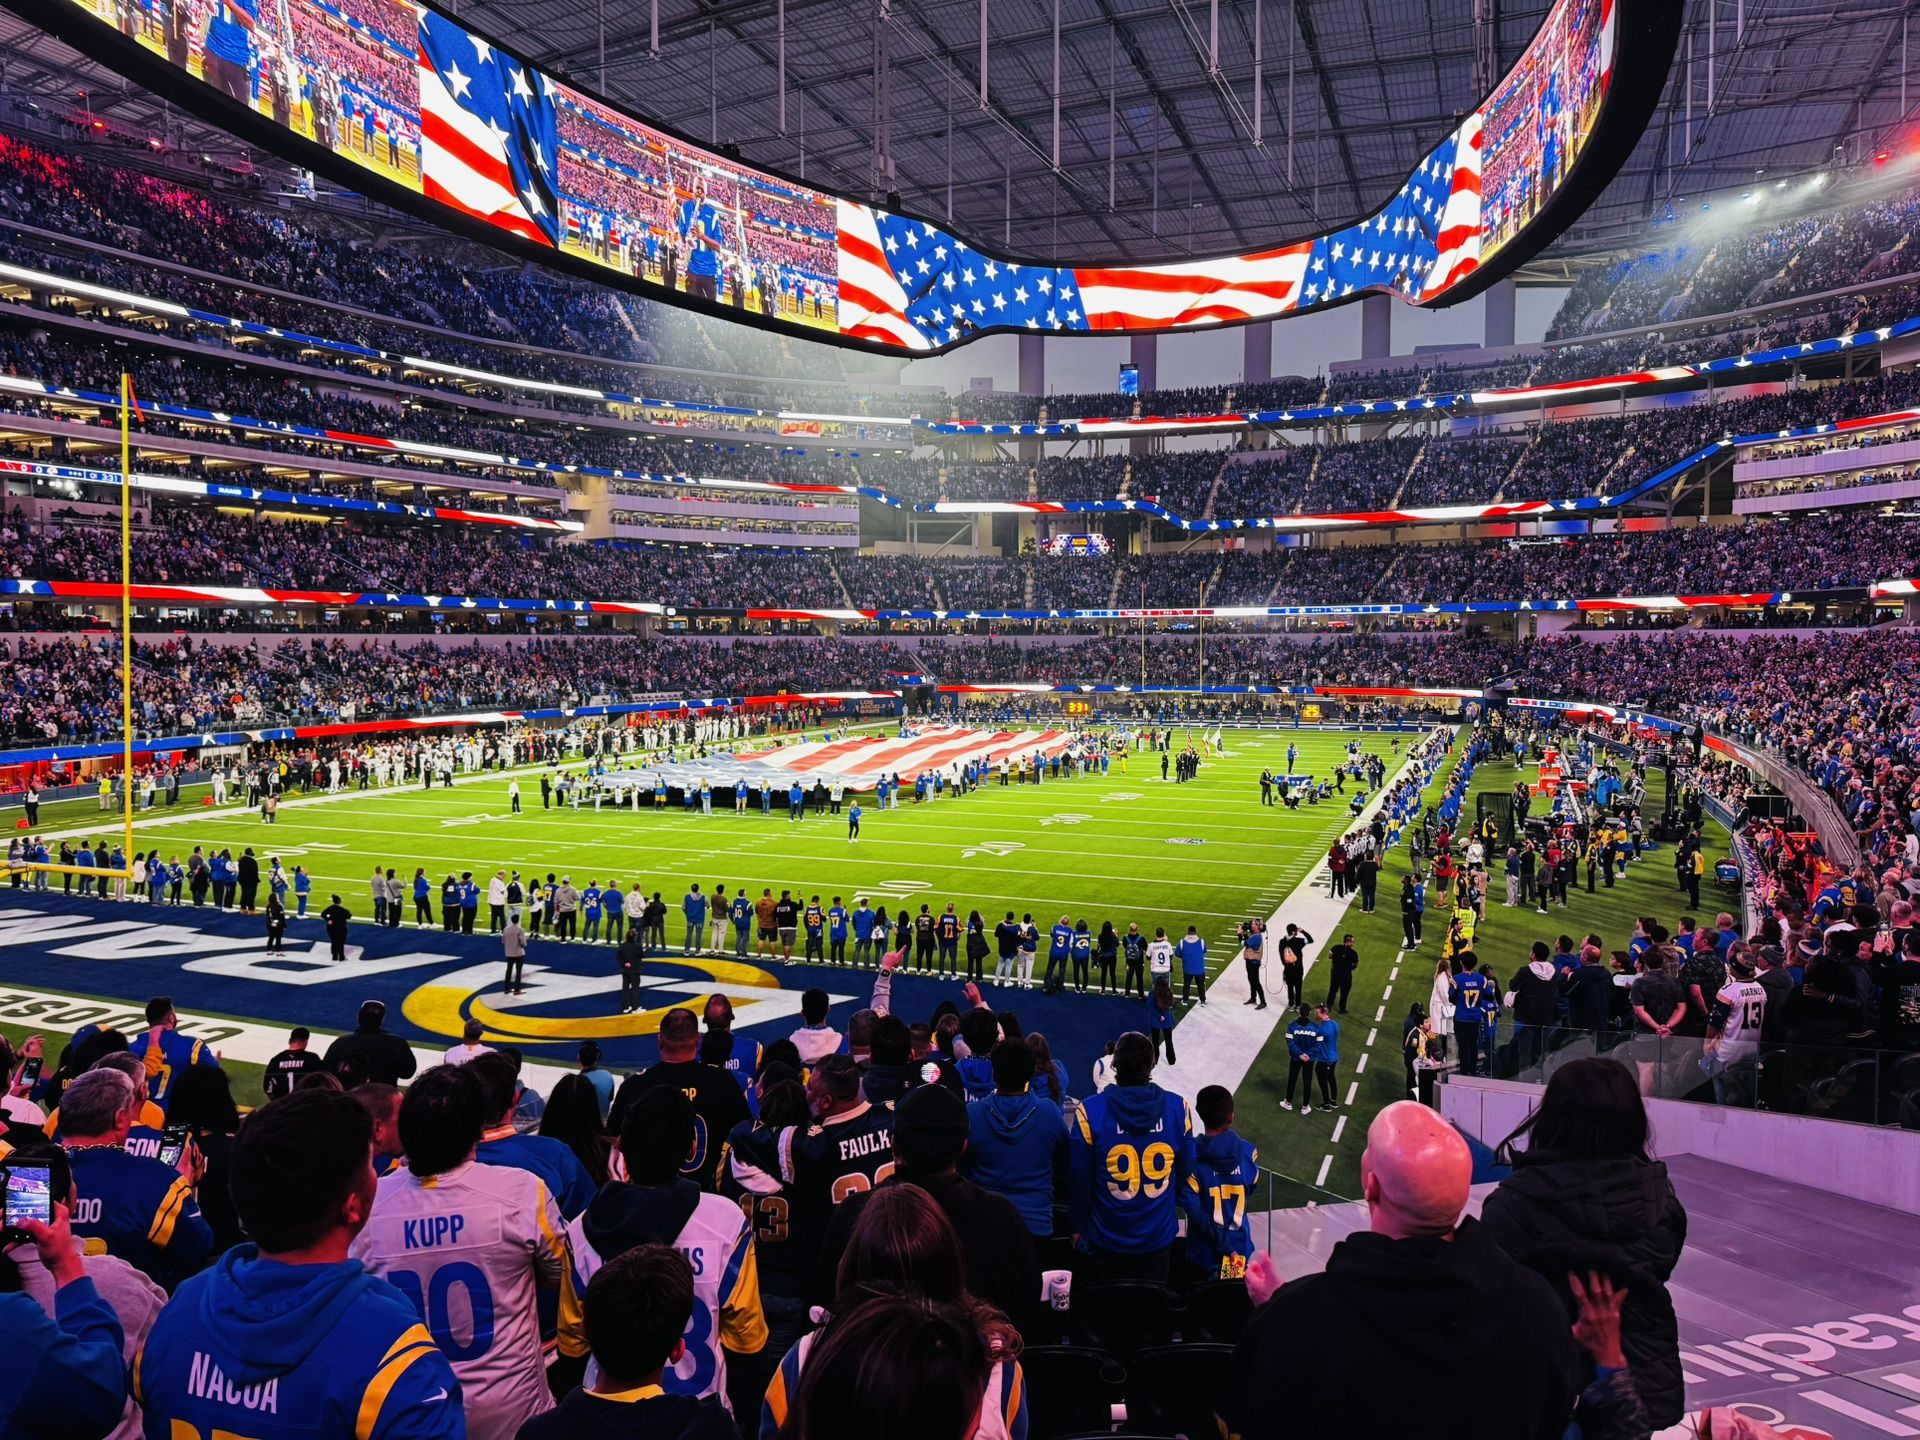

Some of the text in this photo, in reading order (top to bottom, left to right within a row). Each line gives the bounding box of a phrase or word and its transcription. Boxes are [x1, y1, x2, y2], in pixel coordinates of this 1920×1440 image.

[218, 487, 242, 496] RAMS
[807, 914, 820, 926] 99
[1056, 935, 1065, 948] 3
[1158, 952, 1165, 965] 9
[1463, 990, 1480, 1008] 17
[1741, 1002, 1762, 1029] 13
[1293, 1029, 1317, 1037] RAMS
[279, 1059, 305, 1069] MURRAY
[286, 1072, 294, 1093] 1
[839, 1129, 891, 1161] FAULK
[1106, 1142, 1175, 1200] 99
[1209, 1184, 1246, 1230] 17
[404, 1214, 465, 1249] KUPP
